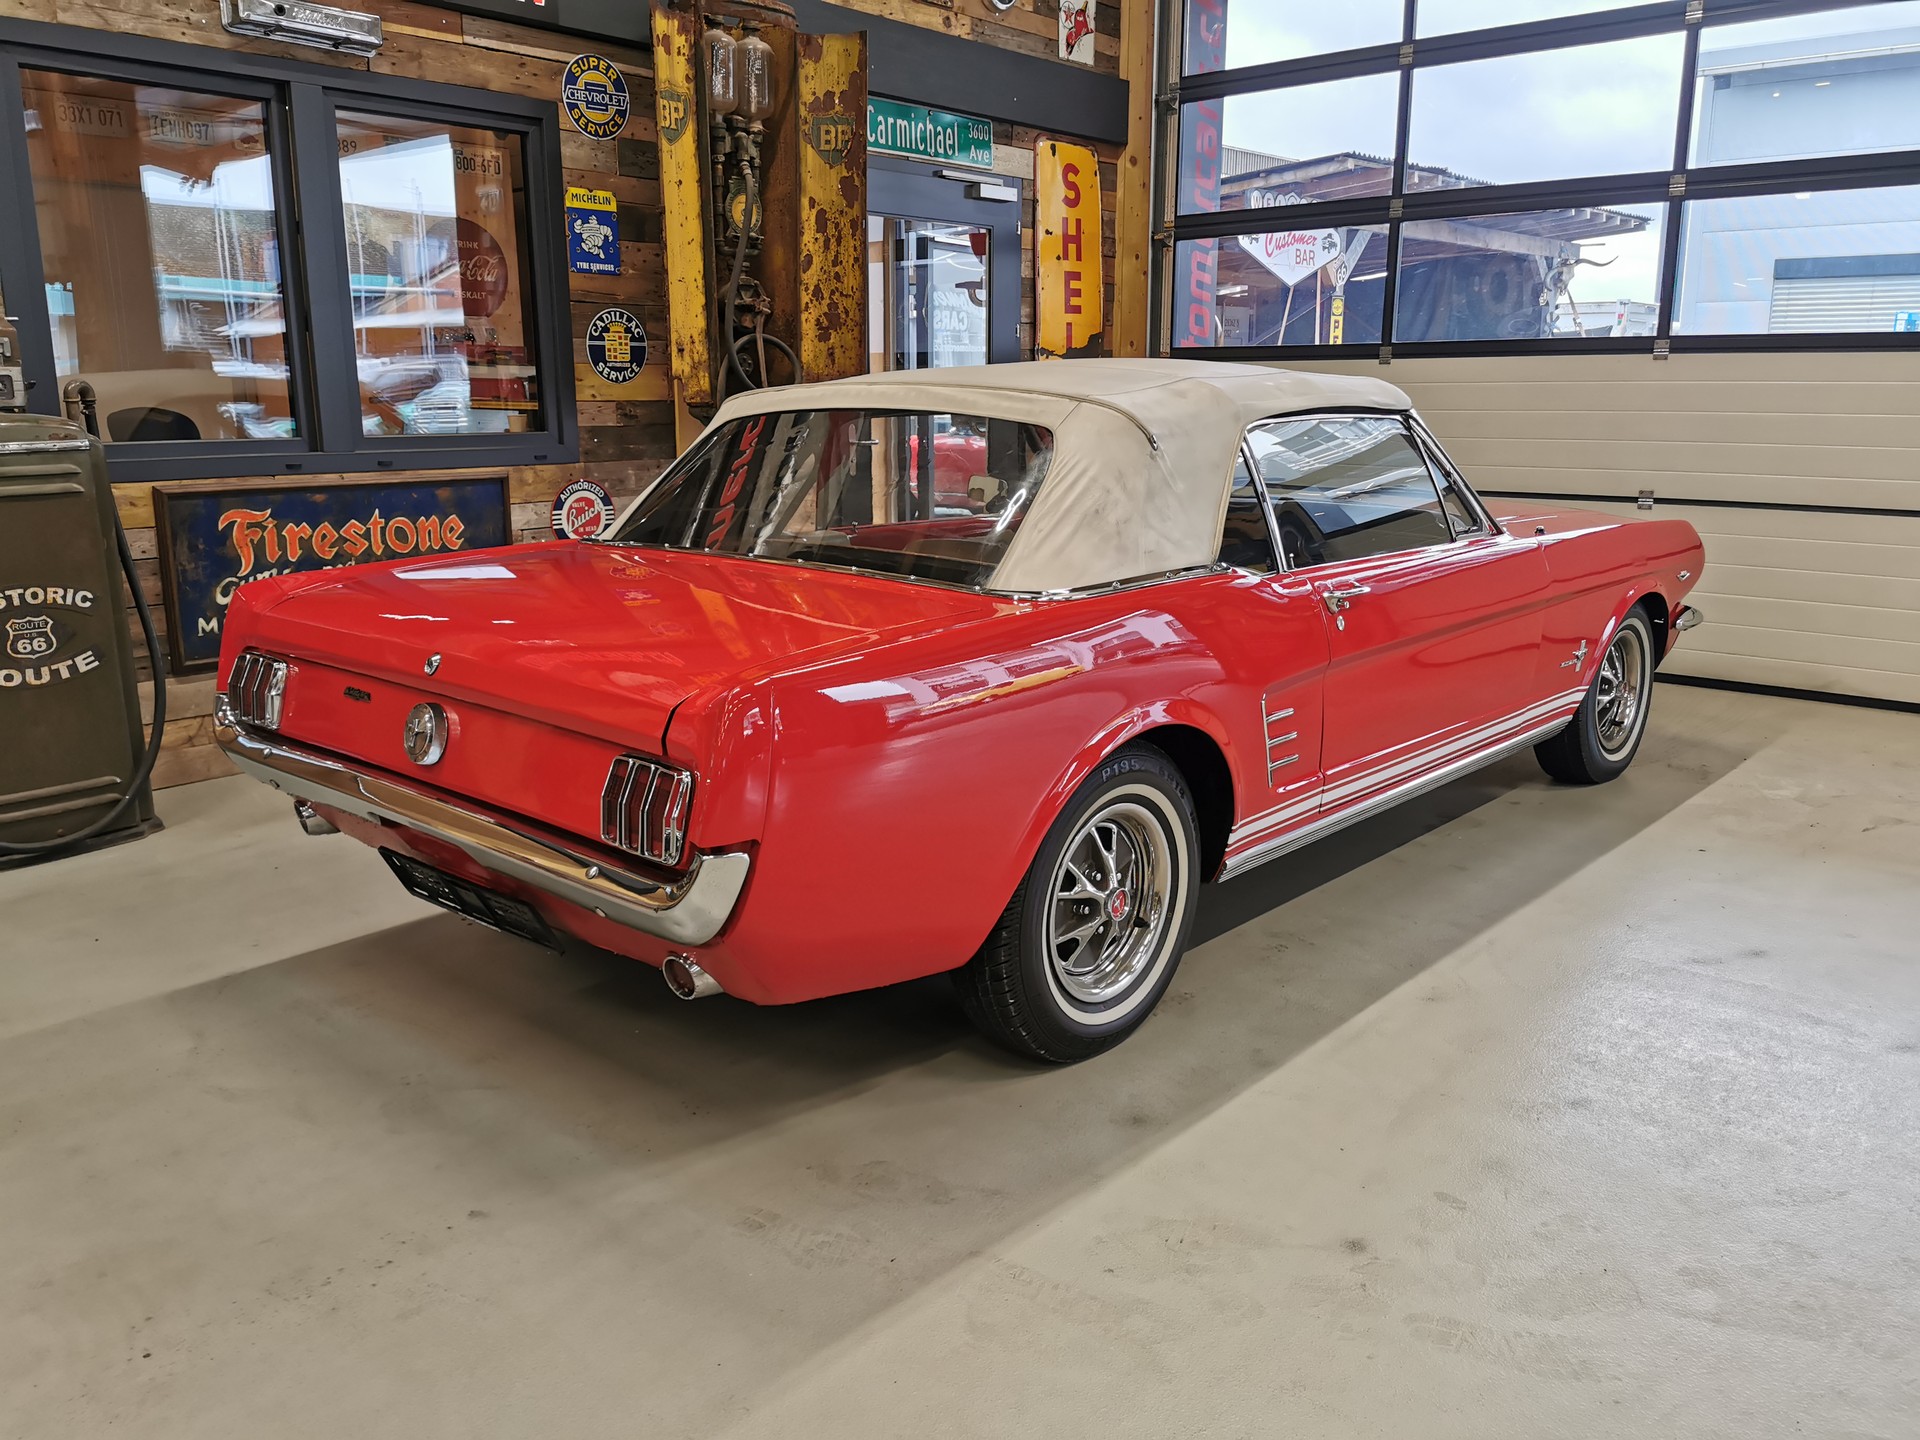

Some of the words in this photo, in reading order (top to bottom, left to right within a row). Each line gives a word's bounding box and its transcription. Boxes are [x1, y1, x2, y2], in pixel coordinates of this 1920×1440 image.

[571, 57, 617, 82] SUPER
[568, 89, 626, 106] CHEVROLET
[98, 109, 123, 127] 071
[571, 108, 624, 136] SERVICE
[660, 98, 685, 130] BP
[819, 124, 852, 151] BP
[867, 104, 959, 157] Carmichael
[968, 122, 989, 141] 3600
[969, 145, 990, 162] Ave
[571, 192, 611, 206] MICHELIN
[1265, 230, 1318, 258] Customer
[576, 261, 590, 270] TYRE
[590, 262, 615, 272] SERVICES
[1295, 248, 1316, 266] BAR
[591, 311, 643, 338] CADILLAC
[596, 361, 640, 381] SERVICE
[560, 482, 605, 502] AUTHORIZED
[568, 498, 603, 535] Buick
[218, 508, 465, 577] Firestone
[12, 620, 47, 630] ROUTE
[17, 637, 47, 653] 66
